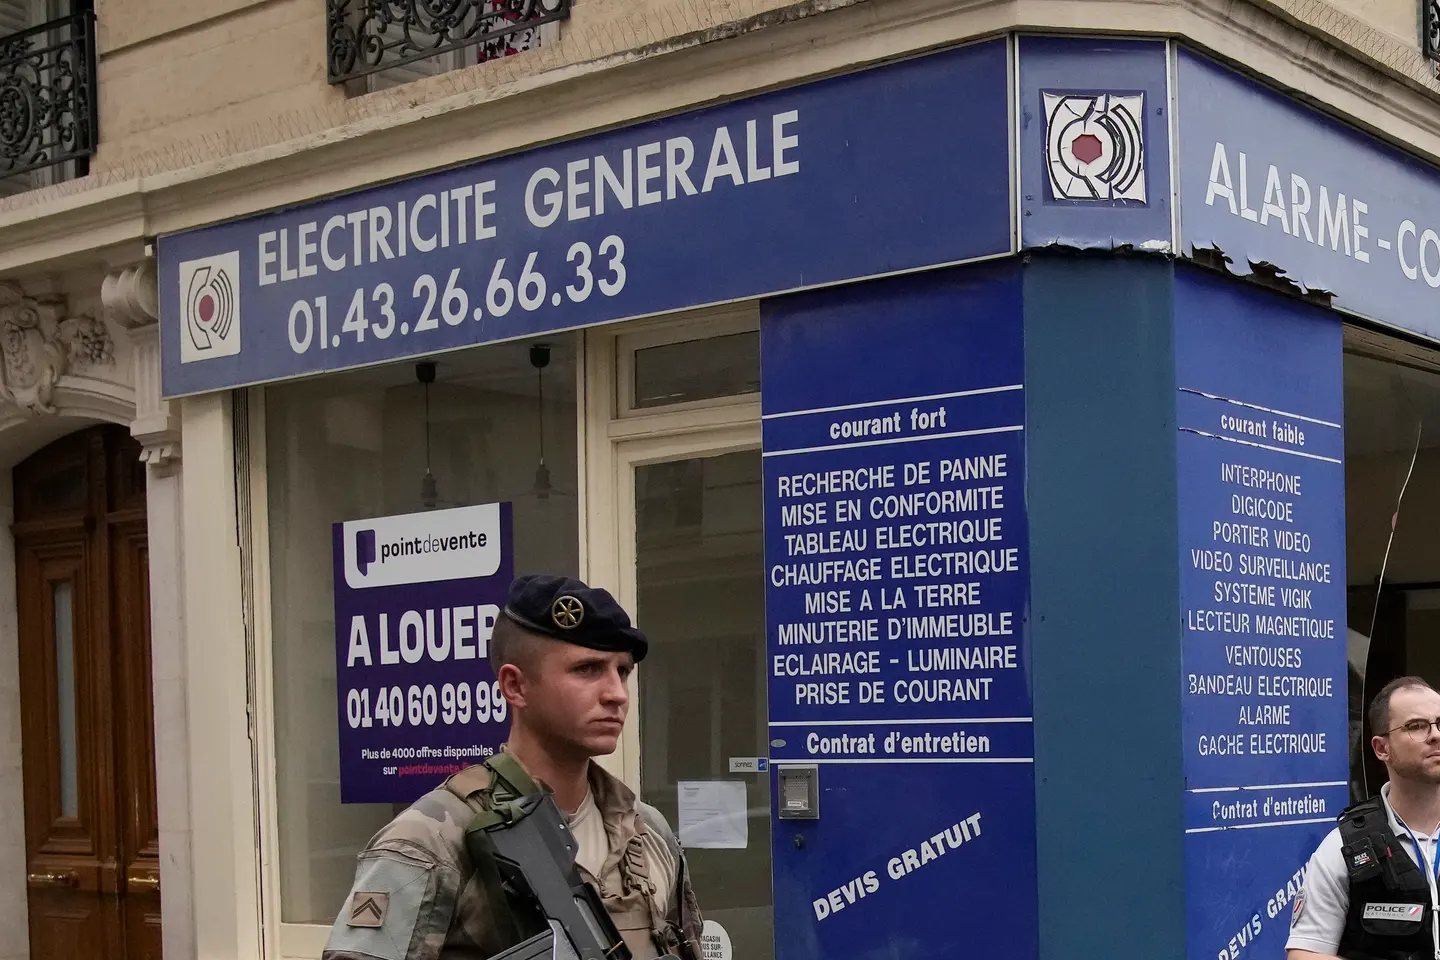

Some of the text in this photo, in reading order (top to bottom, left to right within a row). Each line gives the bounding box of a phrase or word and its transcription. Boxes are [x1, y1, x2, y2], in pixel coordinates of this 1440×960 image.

[258, 110, 800, 286] ELECTRICITE GENERALE
[287, 235, 627, 354] 01.43.26.66.33
[829, 407, 946, 439] courant fort
[1221, 413, 1305, 446] courant faible
[778, 454, 1007, 498] RECHERCHE DE PANNE
[1221, 463, 1302, 496] INTERPHONE
[781, 486, 1004, 527] MISE EN CONFORMITE
[1231, 494, 1293, 523] DIGICODE
[381, 530, 487, 563] pointdevente
[784, 518, 1003, 556] TABLEAU ELECTRIQUE
[1213, 521, 1311, 553] PORTIER VIDEO
[771, 548, 1019, 587] CHAUFFAGE ELECTRIQUE
[1191, 549, 1331, 584] VIDEO SURVEILLANCE
[805, 582, 981, 614] MISE A LA TERRE
[1214, 581, 1312, 610] SYSTEME VIGIK
[778, 612, 1013, 646] MINUTERIE D'IMMEUBLE
[1188, 609, 1334, 639] LECTEUR MAGNETIQUE
[346, 615, 373, 667] A
[1225, 645, 1302, 669] VENTOUSES
[773, 651, 880, 676] ECLAIRAGE
[908, 645, 1017, 672] LUMINAIRE
[796, 677, 993, 705] PRISE DE COURANT
[1189, 674, 1333, 697] BANDEAU ELECTRIQUE
[1238, 704, 1291, 726] ALARME
[361, 745, 494, 760] Plus de 4000 offres disponibles
[806, 731, 990, 754] Contrat d'entretien
[1198, 732, 1326, 756] GACHE ELECTRIQUE
[383, 765, 397, 775] sur
[1212, 794, 1326, 820] Contrat d'entretien
[812, 812, 983, 921] DEVIS GRATUIT
[1267, 861, 1309, 919] GRATU
[1366, 905, 1406, 913] POLICE
